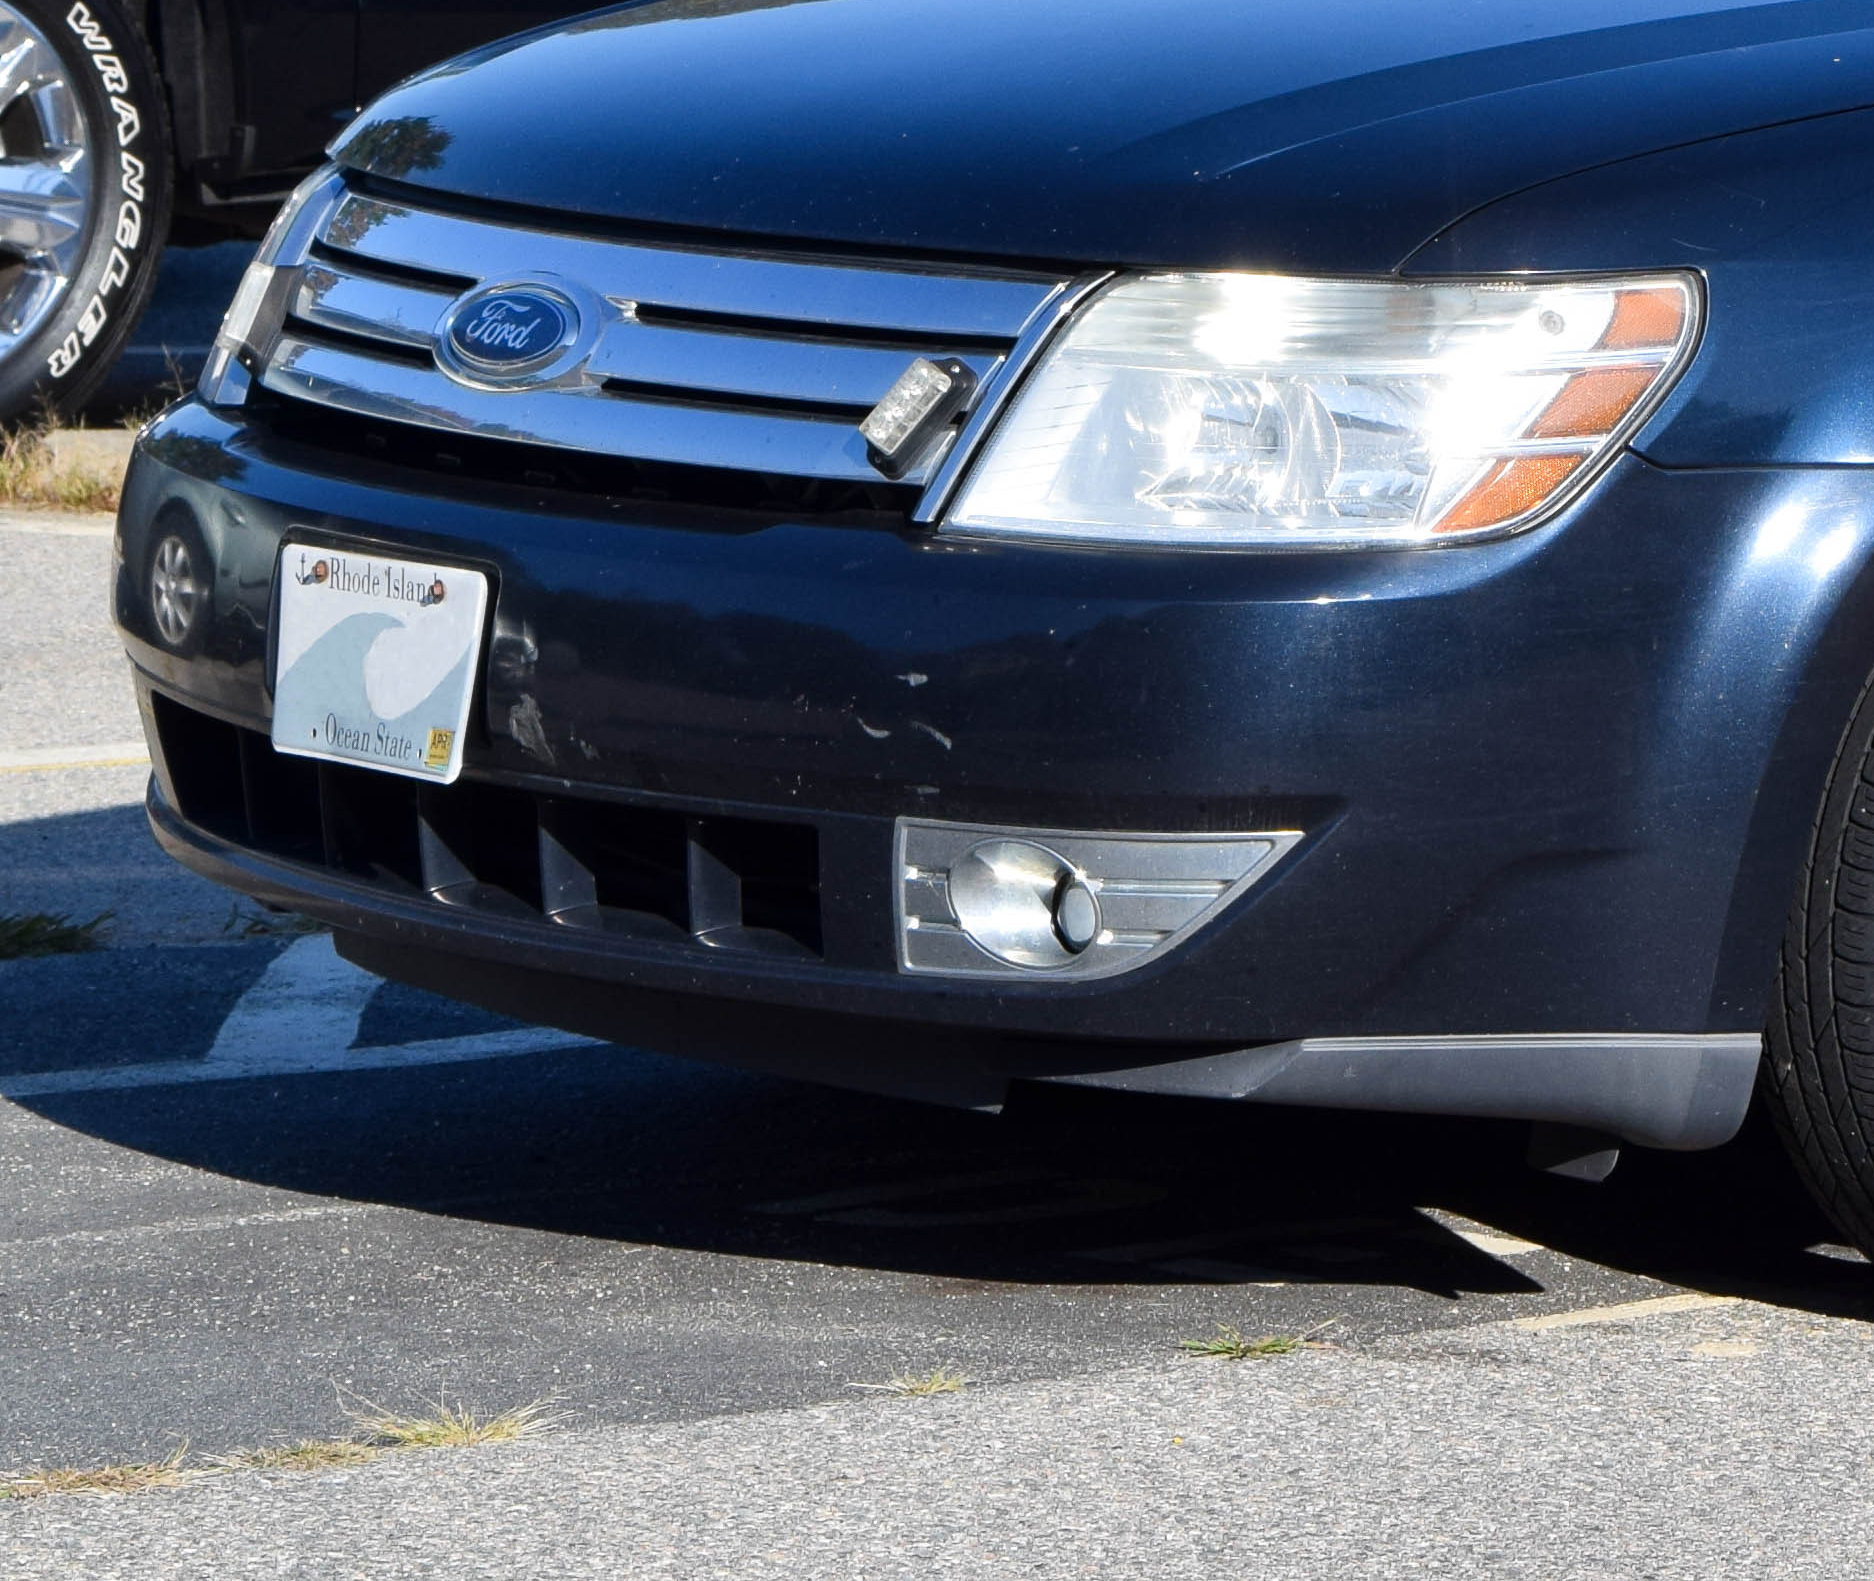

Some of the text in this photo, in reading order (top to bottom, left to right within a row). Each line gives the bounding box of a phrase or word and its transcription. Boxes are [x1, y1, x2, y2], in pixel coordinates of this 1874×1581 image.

[47, 0, 148, 379] WRANGLER
[465, 299, 542, 350] Ford
[329, 556, 442, 603] Rhode Island
[324, 712, 414, 760] Ocean State
